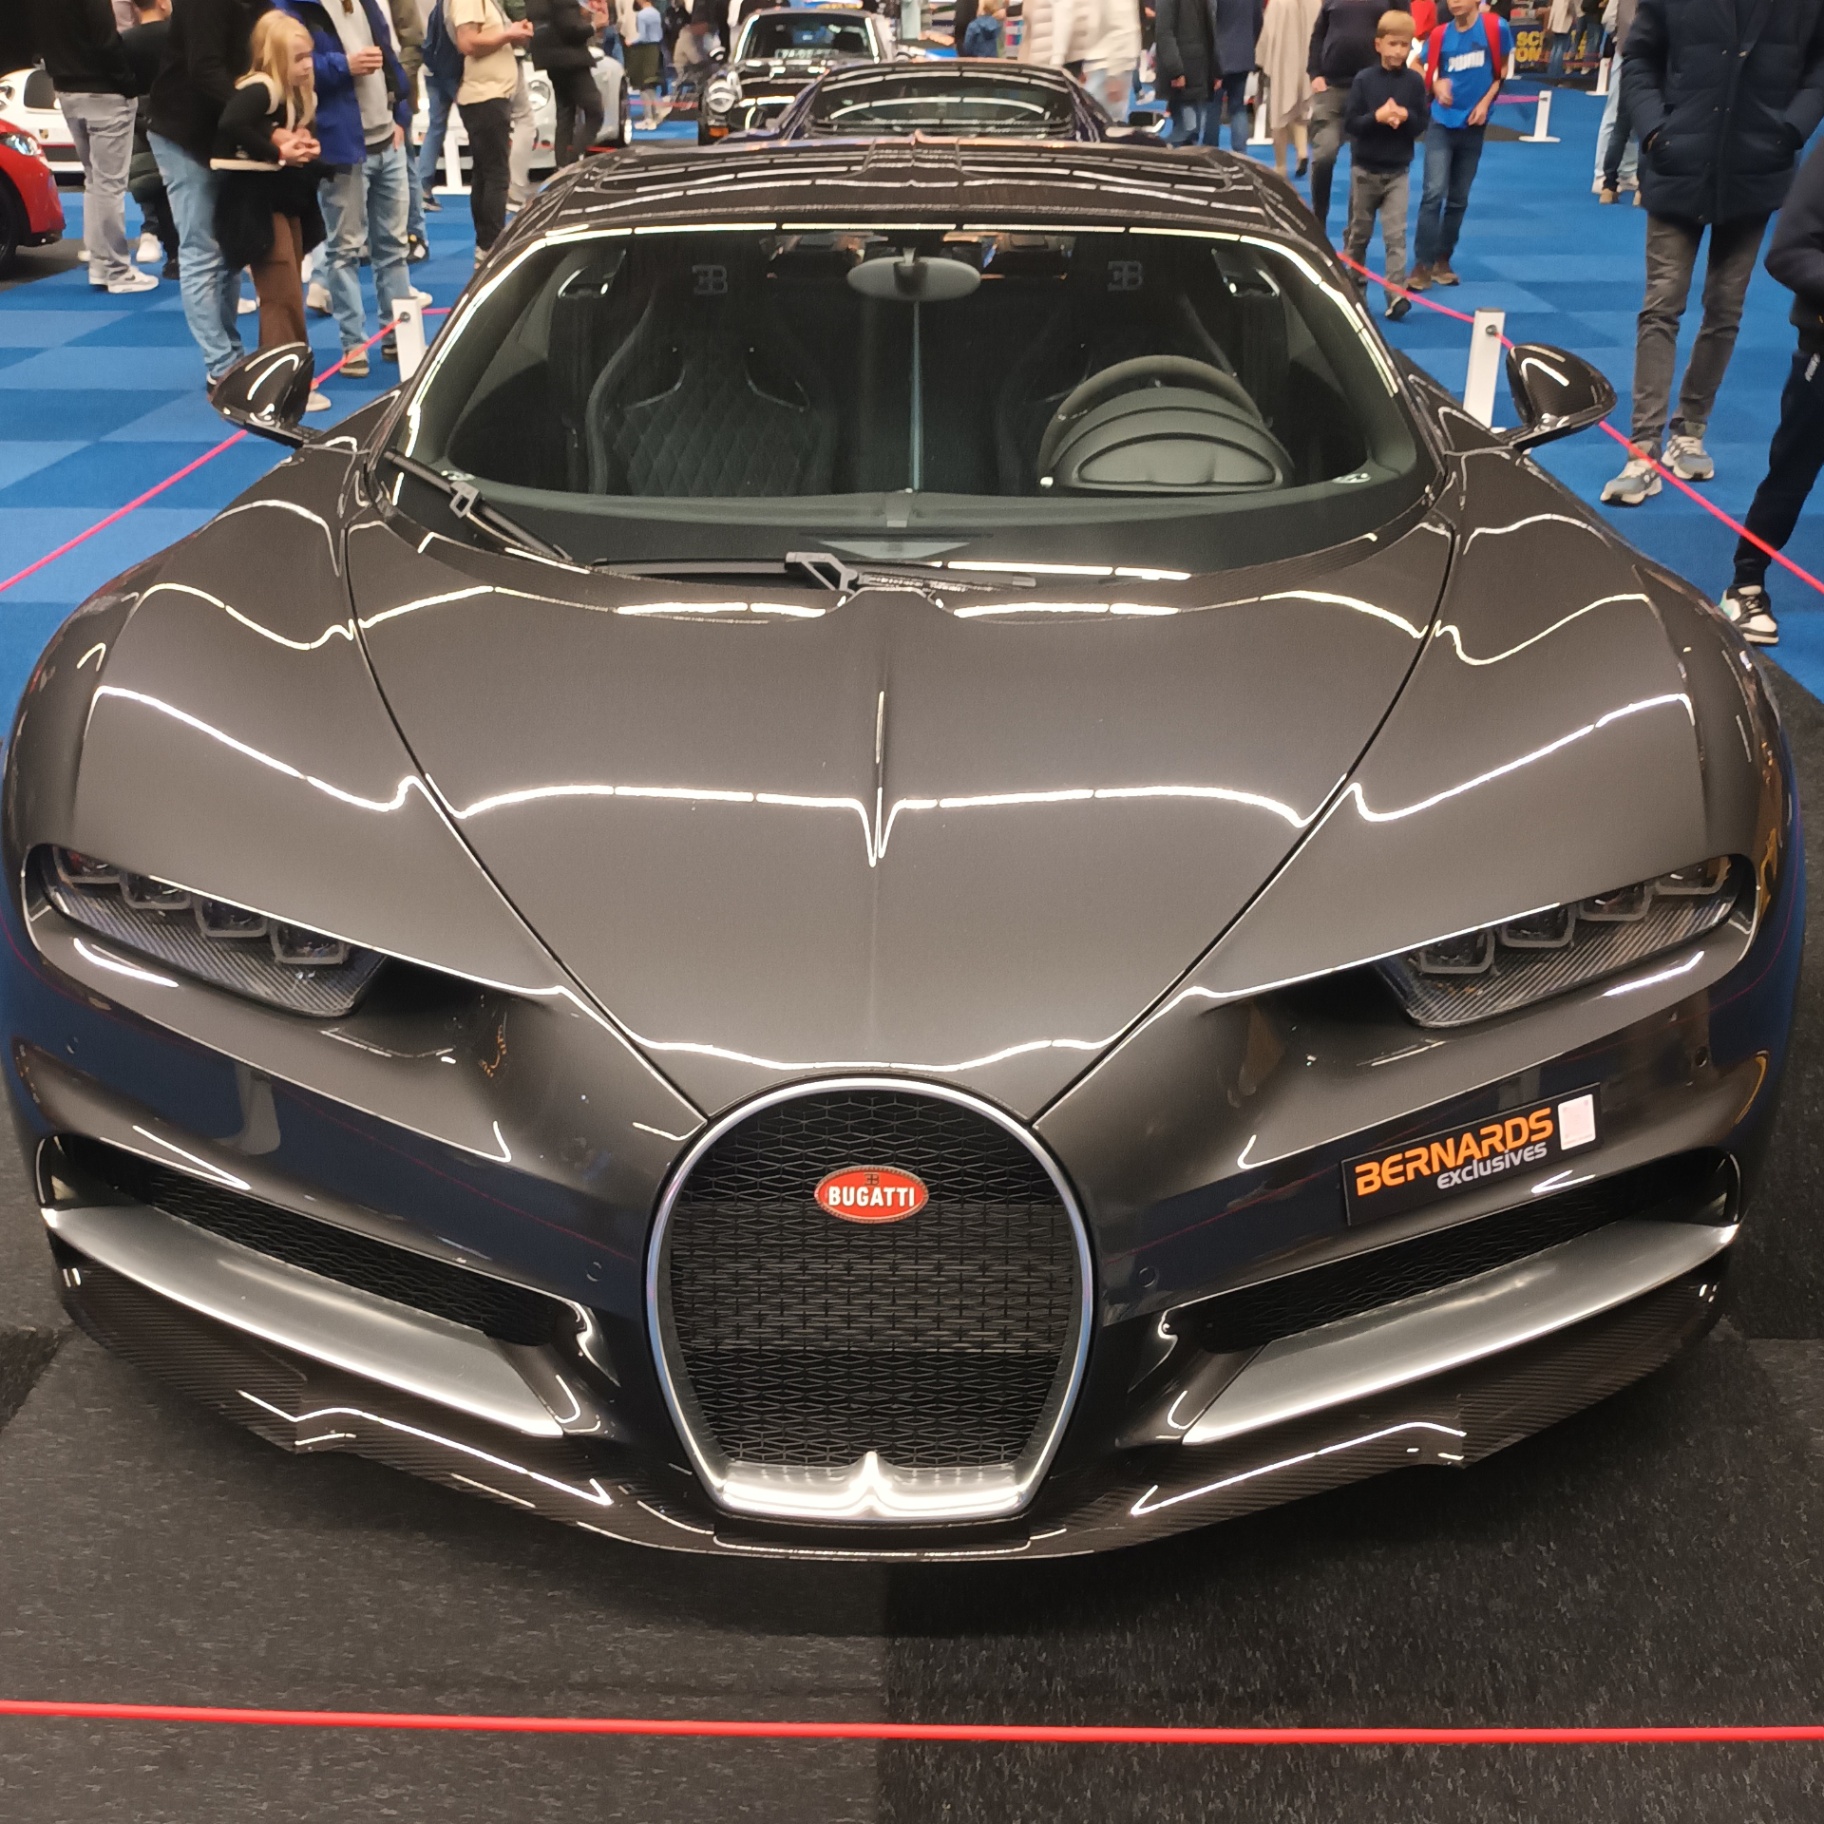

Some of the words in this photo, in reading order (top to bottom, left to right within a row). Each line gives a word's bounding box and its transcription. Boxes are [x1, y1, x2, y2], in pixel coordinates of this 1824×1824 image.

[1355, 1107, 1554, 1196] BERNARDS
[1436, 1142, 1548, 1190] exclusives
[828, 1186, 915, 1207] BUGATTI
